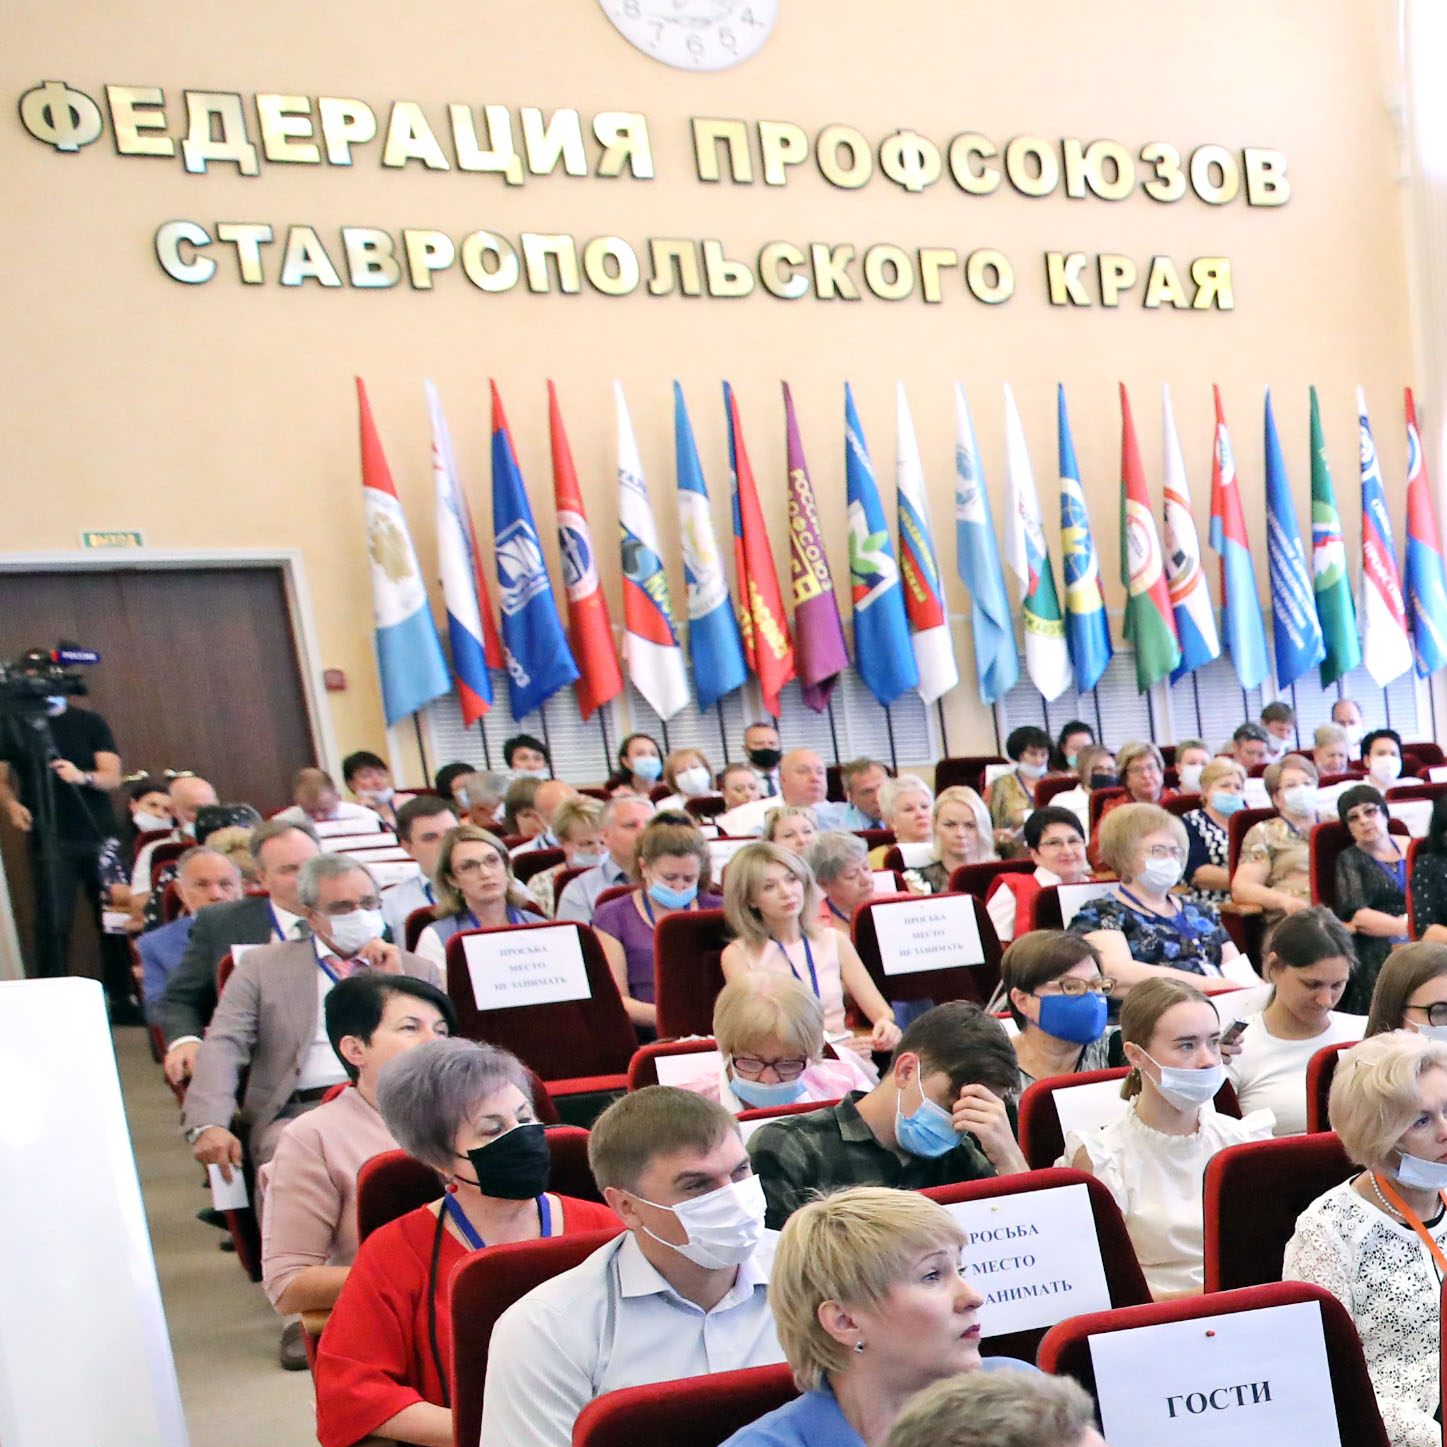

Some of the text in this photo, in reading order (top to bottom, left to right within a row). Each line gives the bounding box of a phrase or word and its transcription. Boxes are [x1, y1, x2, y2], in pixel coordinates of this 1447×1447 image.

[18, 80, 1292, 207] ФЕДЕРАЦИЯ ПРОФСОЮЗОВ
[154, 219, 1235, 311] СТАВРОПОЛЬСКОГО КРАЯ
[904, 913, 947, 925] ПРОСЬБА
[912, 929, 945, 939] МЕСТО
[499, 945, 548, 957] ПРОСЬБА
[509, 962, 547, 972] МЕСТО
[512, 976, 568, 989] ЗАНИМАТЬ
[966, 1223, 1039, 1246] РОСЬБА
[972, 1253, 1036, 1277] МЕСТО
[984, 1278, 1073, 1307] АНИМАТЬ
[1164, 1379, 1273, 1419] ГОСТИ
